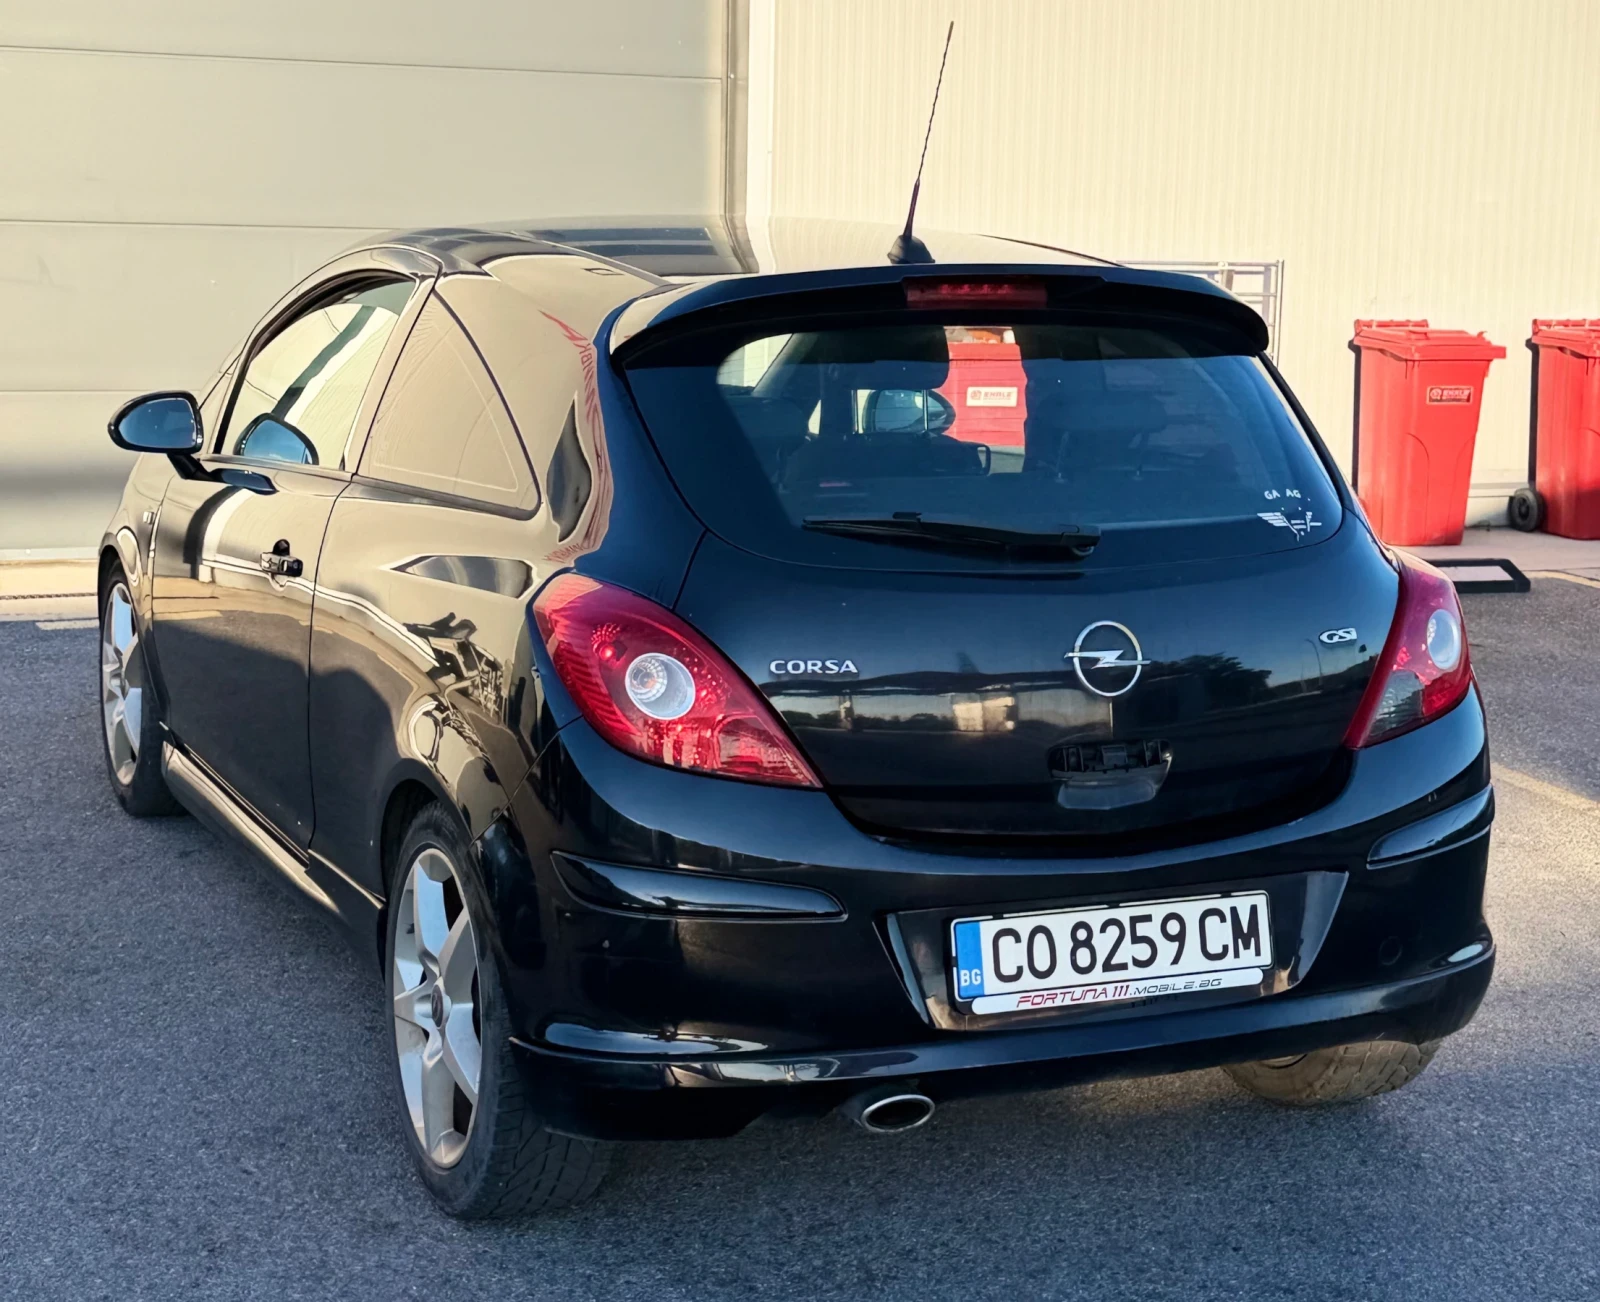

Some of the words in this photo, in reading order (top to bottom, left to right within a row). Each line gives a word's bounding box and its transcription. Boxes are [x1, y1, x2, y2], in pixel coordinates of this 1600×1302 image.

[769, 659, 858, 674] CORSA
[992, 924, 1057, 983] CO
[1069, 911, 1187, 976] 8259
[1198, 903, 1262, 962] CM
[960, 968, 982, 986] BG
